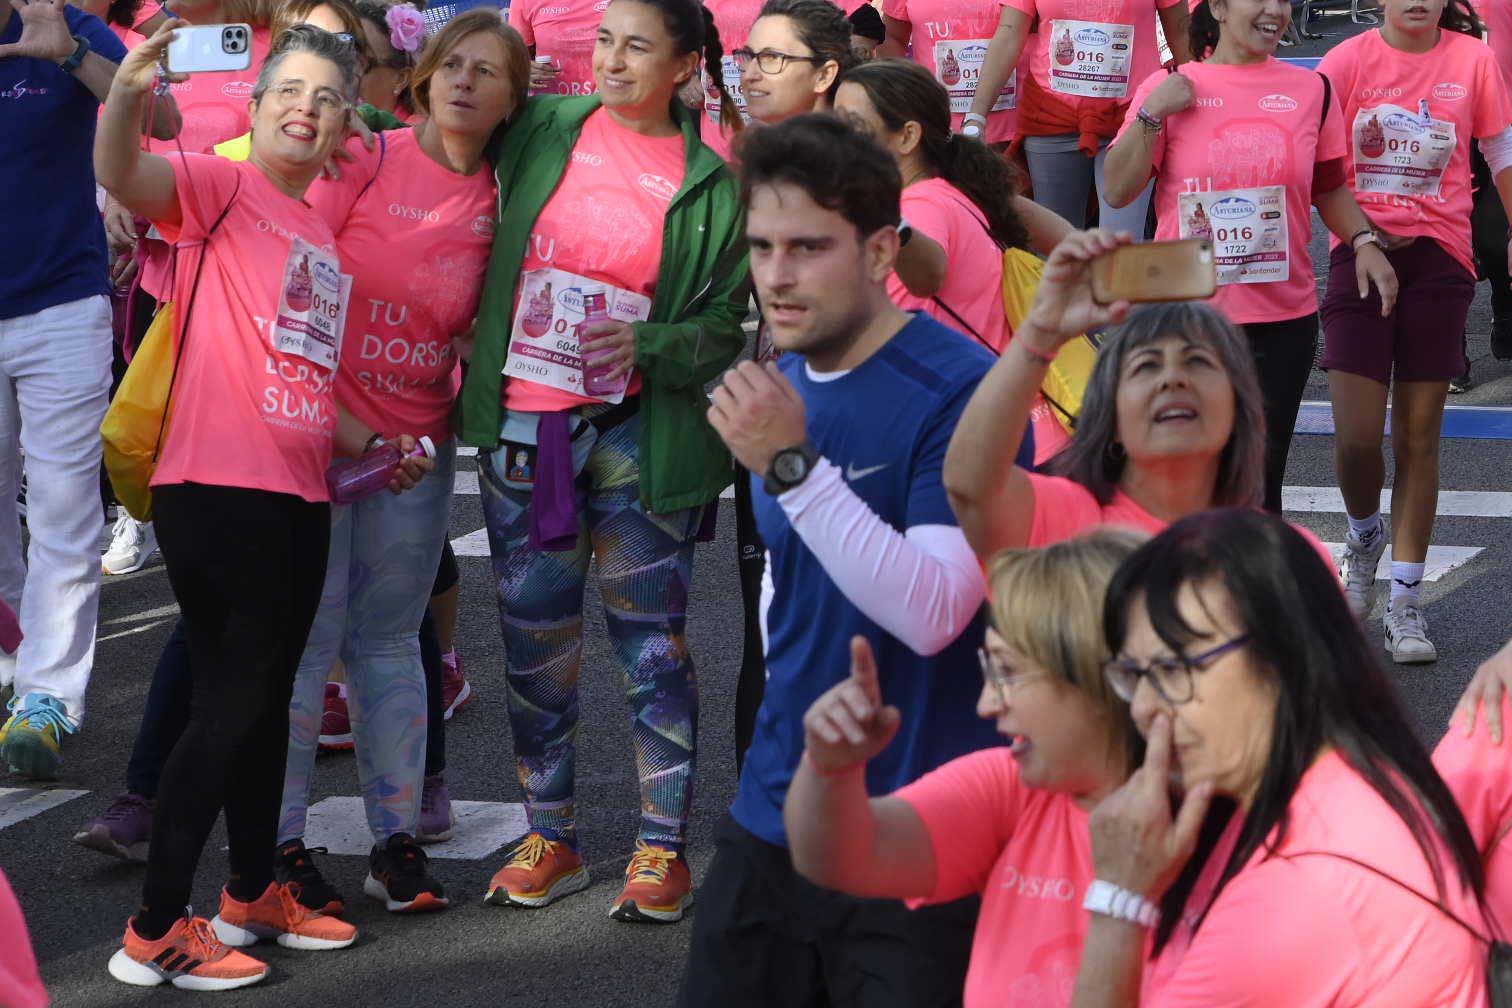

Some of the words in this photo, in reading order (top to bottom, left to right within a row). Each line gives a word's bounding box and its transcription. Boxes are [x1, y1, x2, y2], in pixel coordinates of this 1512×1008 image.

[924, 21, 950, 39] TU
[1077, 32, 1108, 44] ASTURIANA
[1076, 51, 1105, 63] 016
[962, 68, 980, 79] 01
[171, 83, 193, 91] SHO
[965, 81, 978, 89] 282
[1362, 87, 1402, 98] OYSHO
[1433, 88, 1465, 97] ASTURIANA
[1196, 97, 1223, 108] SHO
[1261, 100, 1295, 110] ASTURIANA
[1388, 138, 1420, 153] 016
[572, 151, 601, 166] SHO
[1393, 155, 1412, 165] 1723
[1362, 177, 1389, 186] OYSHO
[388, 203, 440, 223] OYSHO
[1214, 205, 1253, 215] ASTURIANA
[1217, 226, 1253, 242] 016
[1225, 245, 1247, 254] 1722
[313, 293, 337, 319] 016
[367, 298, 408, 326] TU
[555, 318, 581, 338] 01
[360, 335, 449, 368] DORSA
[552, 353, 563, 363] DE
[564, 356, 573, 365] LA
[514, 360, 549, 376] OYSHO
[1031, 403, 1050, 423] OYS
[1000, 866, 1075, 901] OYSHO
